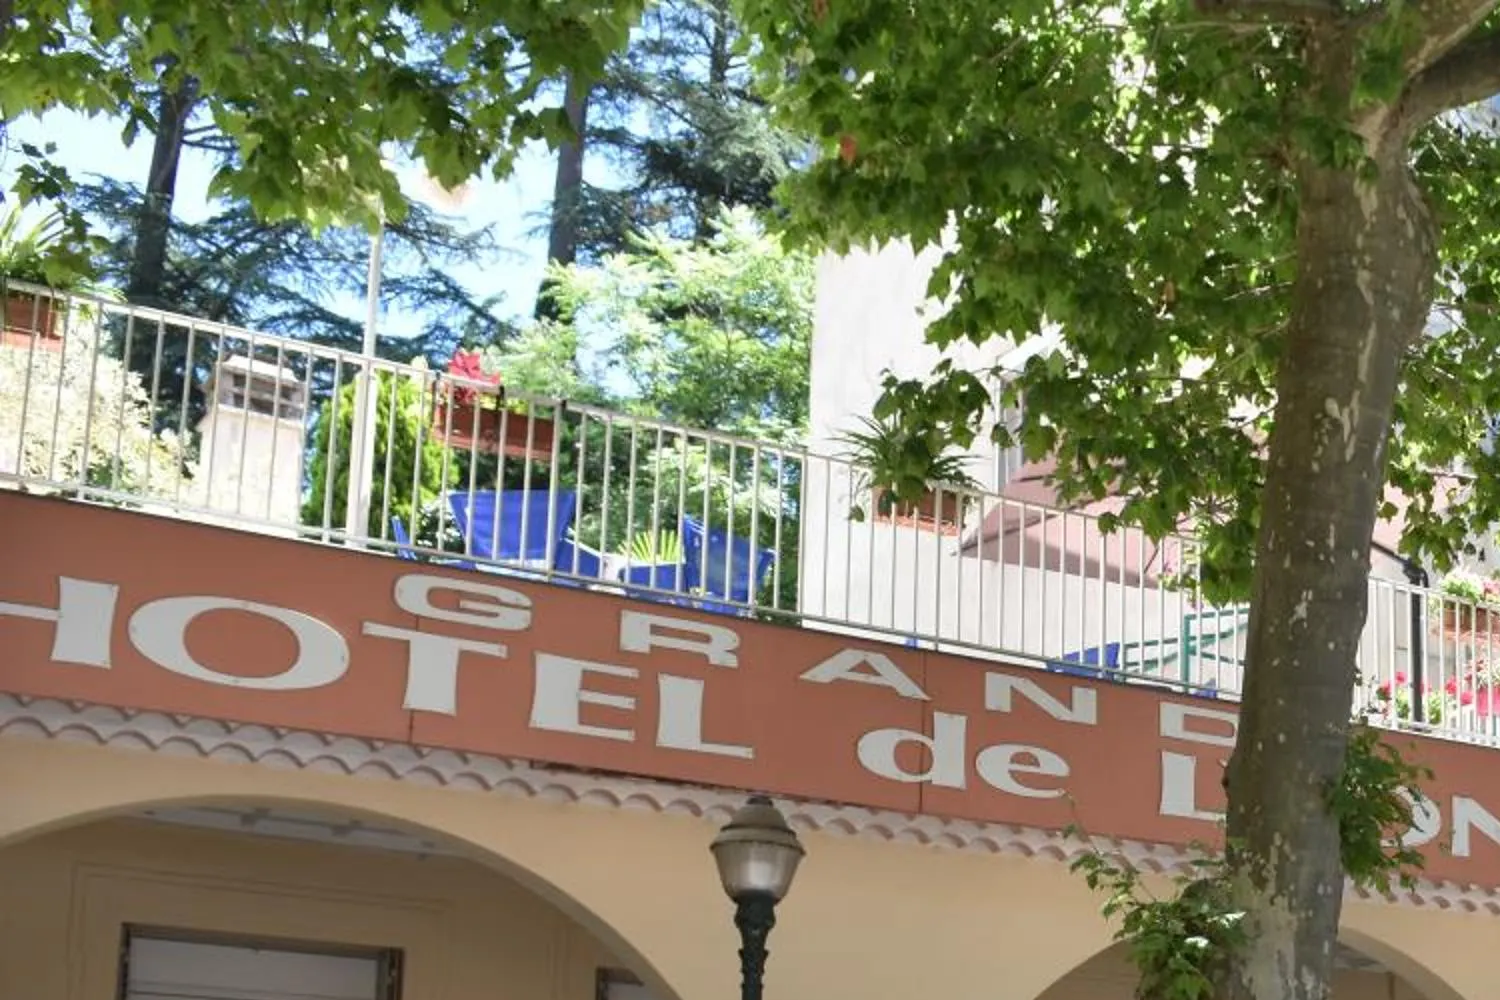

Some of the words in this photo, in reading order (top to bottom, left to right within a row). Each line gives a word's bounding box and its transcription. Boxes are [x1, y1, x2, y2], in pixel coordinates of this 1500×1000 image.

[0, 575, 755, 759] HOTEL
[856, 710, 1070, 799] de
[393, 572, 1241, 748] GRAND
